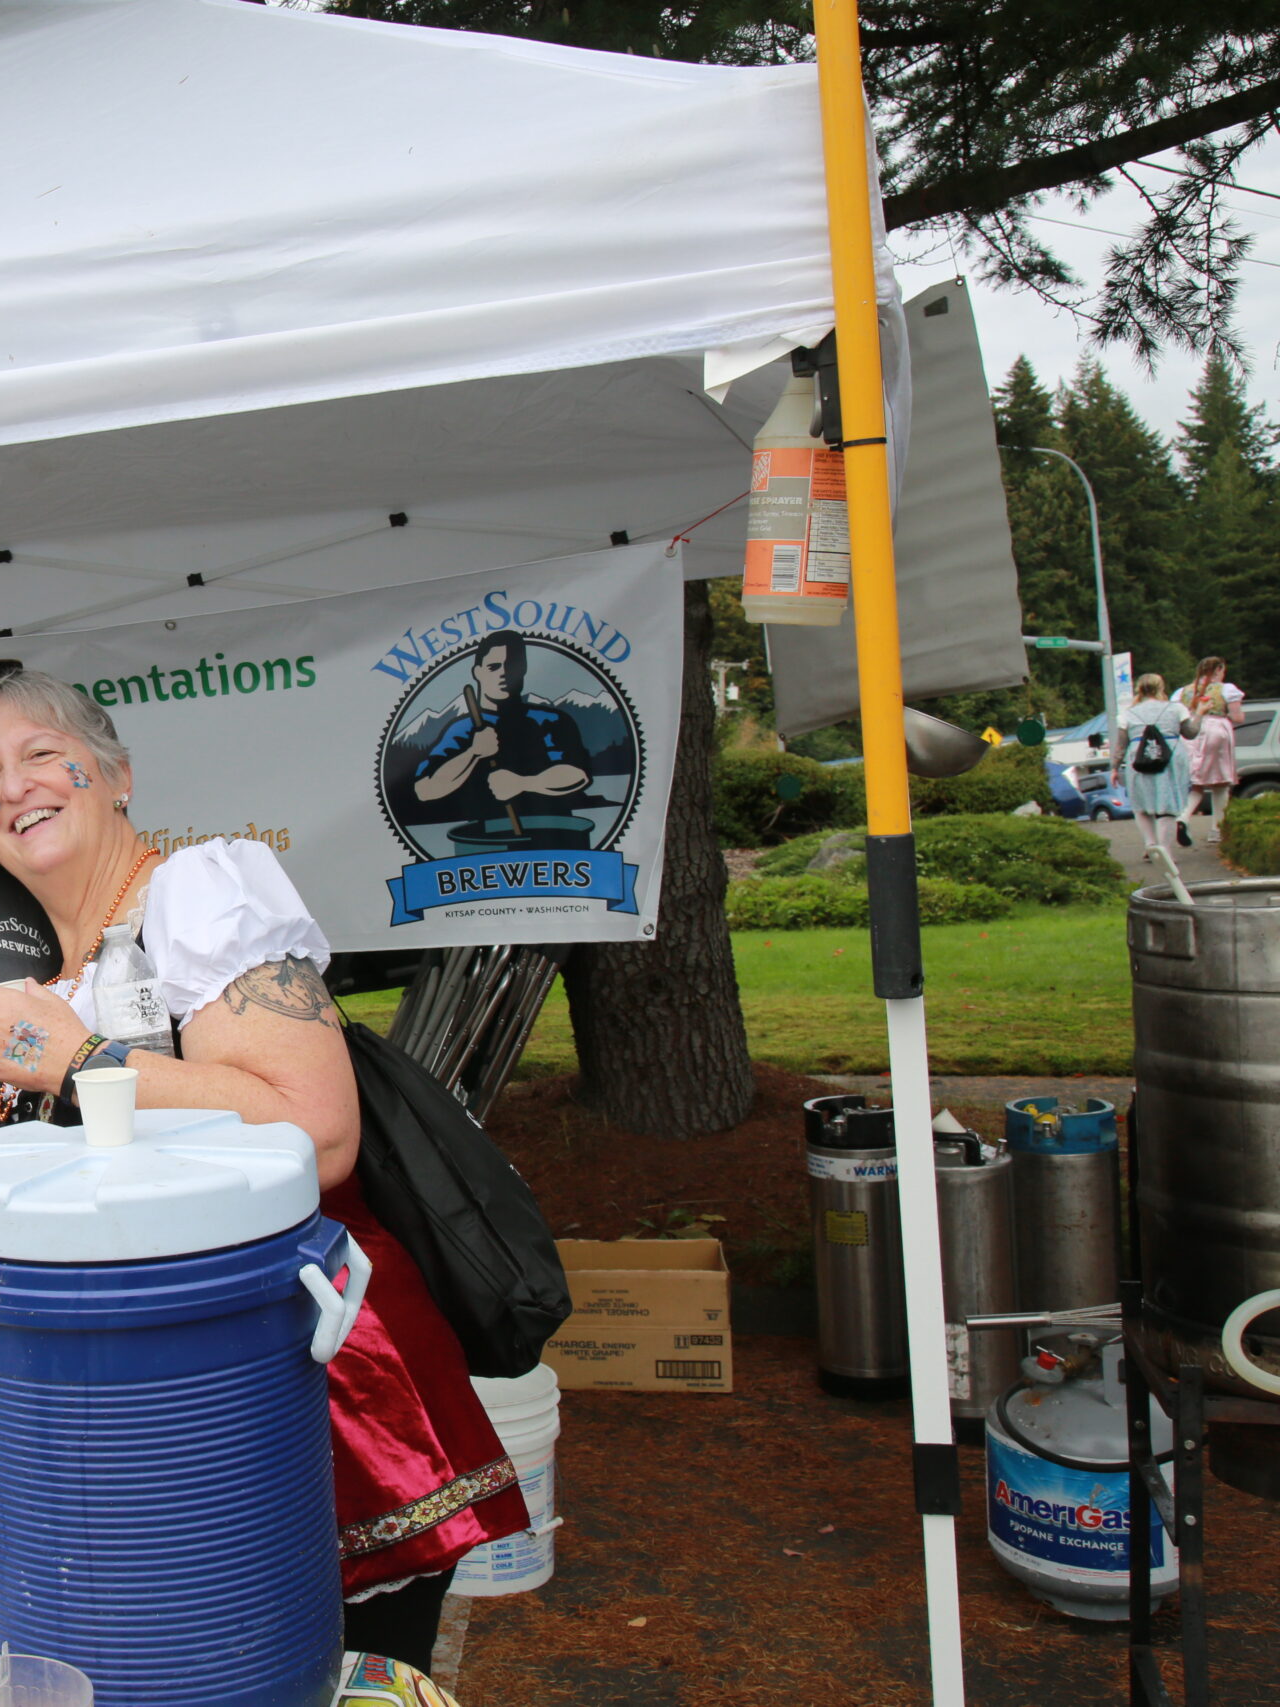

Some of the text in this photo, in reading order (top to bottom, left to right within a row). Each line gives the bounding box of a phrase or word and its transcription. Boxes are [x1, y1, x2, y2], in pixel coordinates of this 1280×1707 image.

[436, 861, 592, 896] BREWERS
[445, 905, 590, 918] KITSAP COUNTY WASHINGTON
[70, 1035, 103, 1069] LOVE IS
[853, 1163, 897, 1177] WARN
[547, 1340, 637, 1350] CHARGEL ENERGY
[1009, 1518, 1126, 1551] PROPANE EXCHANGE
